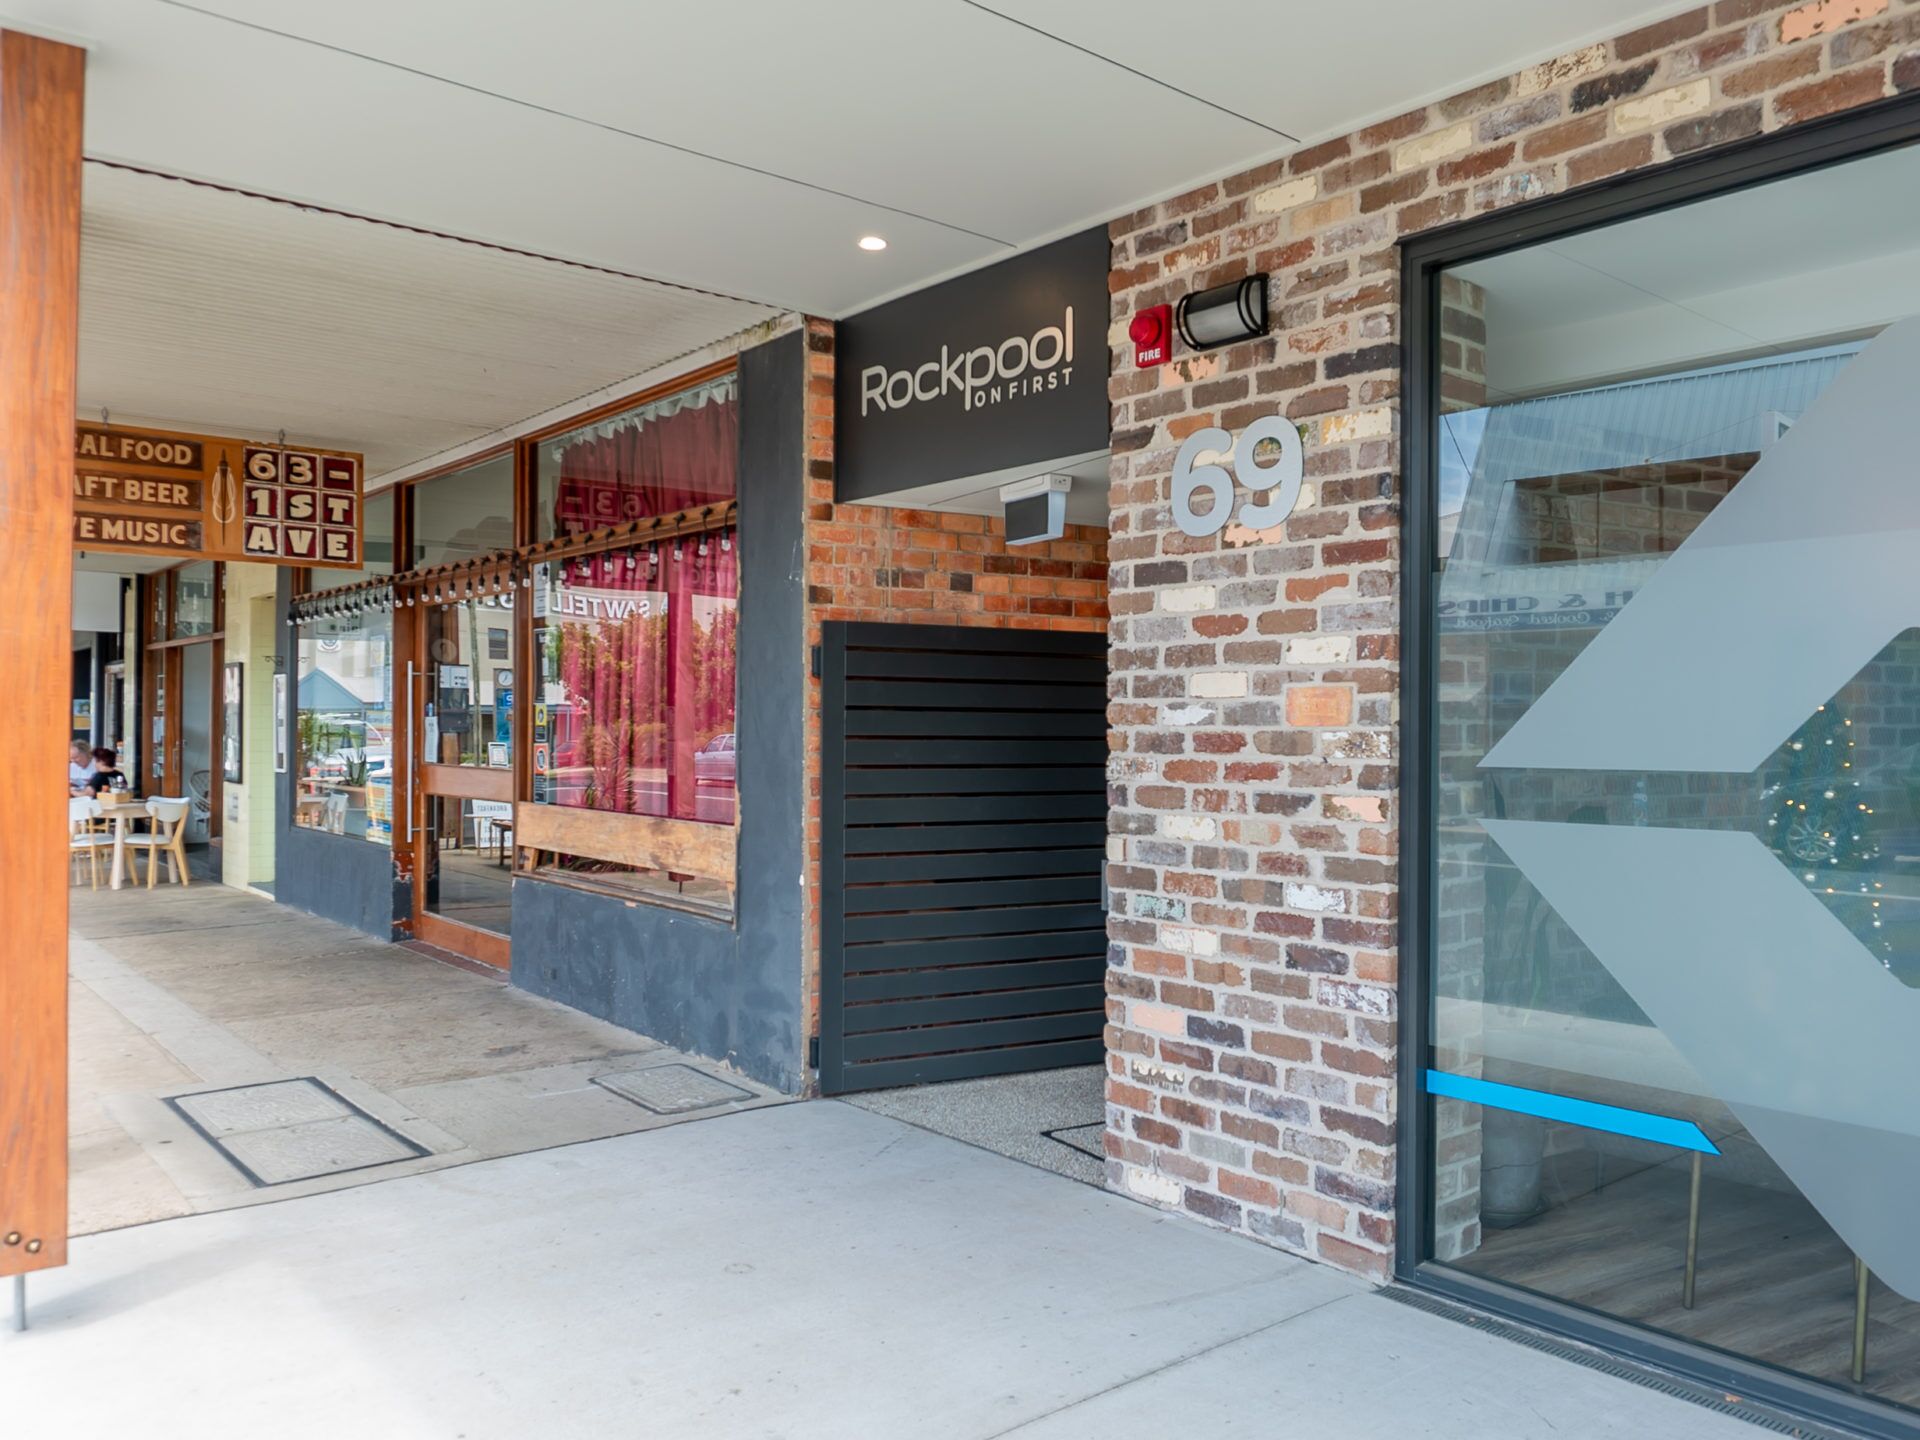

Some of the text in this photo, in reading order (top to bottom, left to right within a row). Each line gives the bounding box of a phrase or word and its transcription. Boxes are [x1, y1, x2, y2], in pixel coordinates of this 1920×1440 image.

[861, 306, 1074, 417] Rockpool
[1138, 347, 1161, 363] FIRE
[974, 367, 1073, 407] ON FIRST
[74, 433, 193, 465] AL FOOD
[248, 452, 350, 484] 63-
[1170, 415, 1304, 537] 69
[124, 479, 189, 506] BEER
[251, 488, 350, 523] 1ST
[73, 515, 187, 545] E MUSIC
[247, 525, 350, 558] AVE
